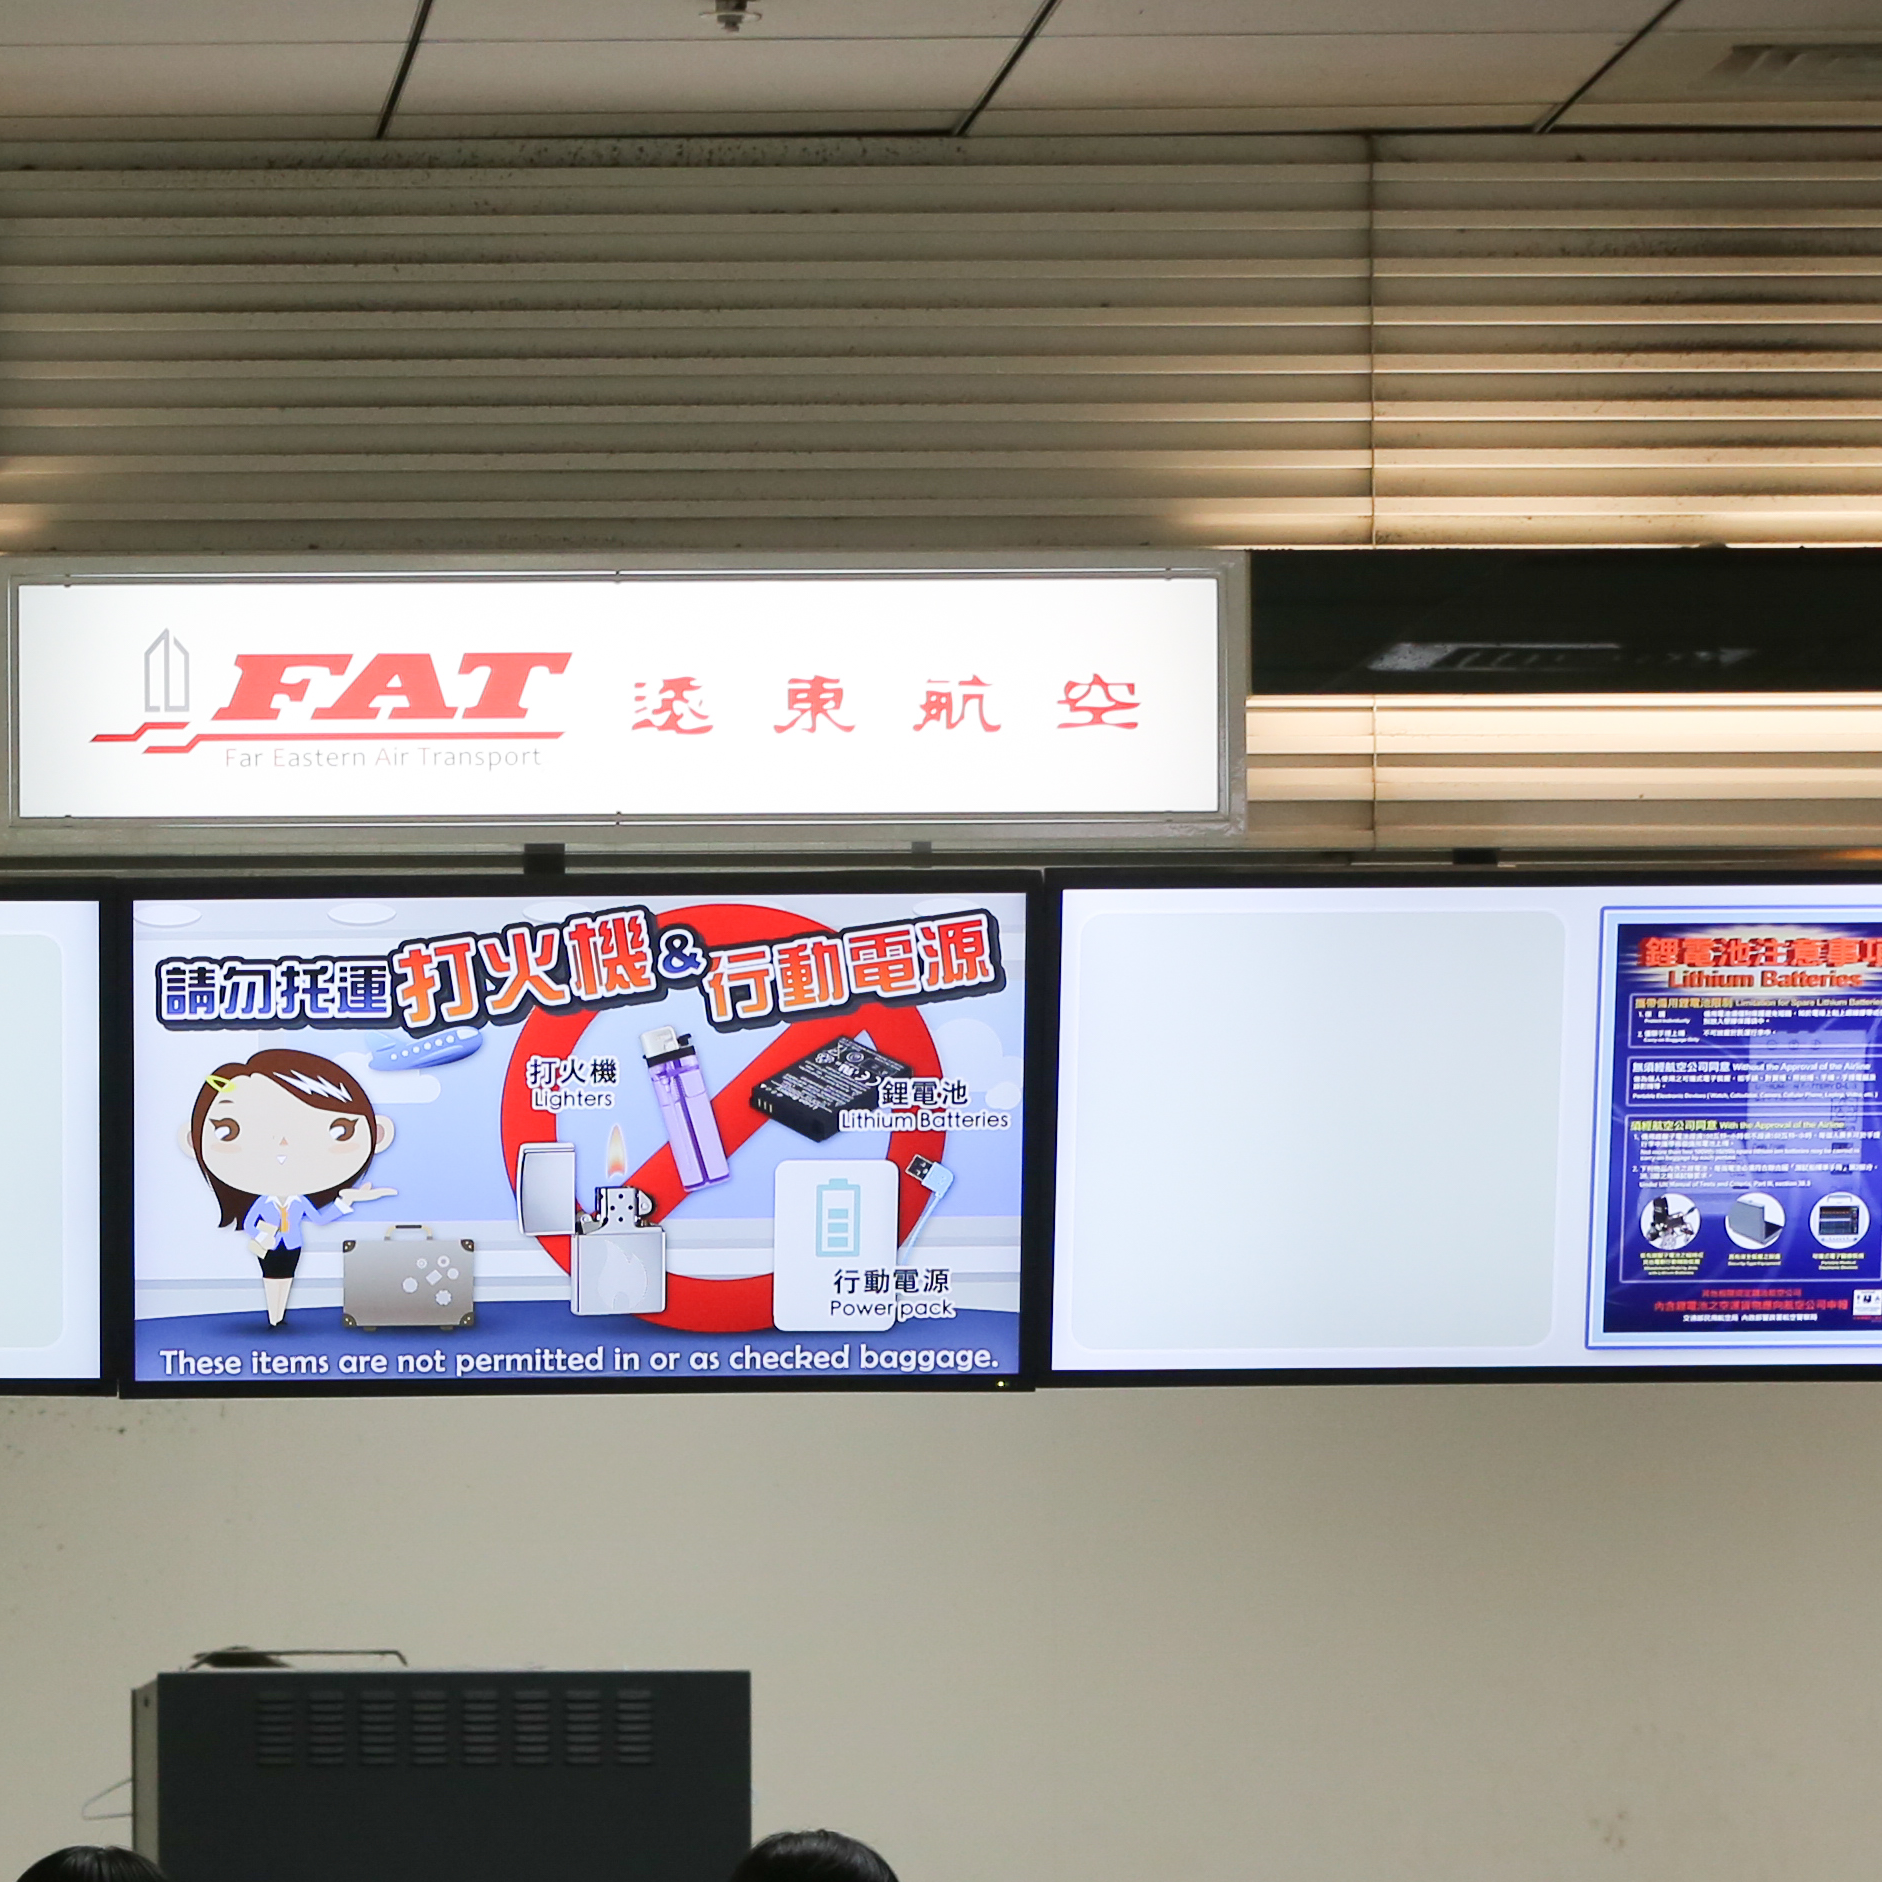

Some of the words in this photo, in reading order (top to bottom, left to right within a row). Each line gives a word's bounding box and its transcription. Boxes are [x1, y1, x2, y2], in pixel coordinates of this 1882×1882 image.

[211, 652, 573, 722] FAT
[225, 748, 264, 767] Far
[273, 748, 366, 767] Eastern
[375, 747, 409, 767] Air
[421, 747, 542, 771] Transport
[1668, 970, 1754, 988] Lithium
[1760, 970, 1865, 988] Batteries
[528, 1058, 618, 1087] 打火機
[534, 1088, 613, 1110] Lighters
[882, 1079, 969, 1106] 鋰電池
[842, 1111, 912, 1128] Lithium
[920, 1111, 1009, 1128] Batteries
[834, 1268, 950, 1295] 行動電源
[830, 1297, 891, 1318] Power
[897, 1298, 956, 1320] pack
[159, 1349, 244, 1376] These
[250, 1349, 329, 1375] items
[336, 1357, 386, 1375] are
[396, 1350, 444, 1375] not
[454, 1347, 605, 1377] permitted
[612, 1347, 640, 1372] in
[649, 1353, 680, 1372] or
[690, 1352, 721, 1372] as
[730, 1345, 850, 1371] checked
[859, 1345, 1000, 1374] baggage.
